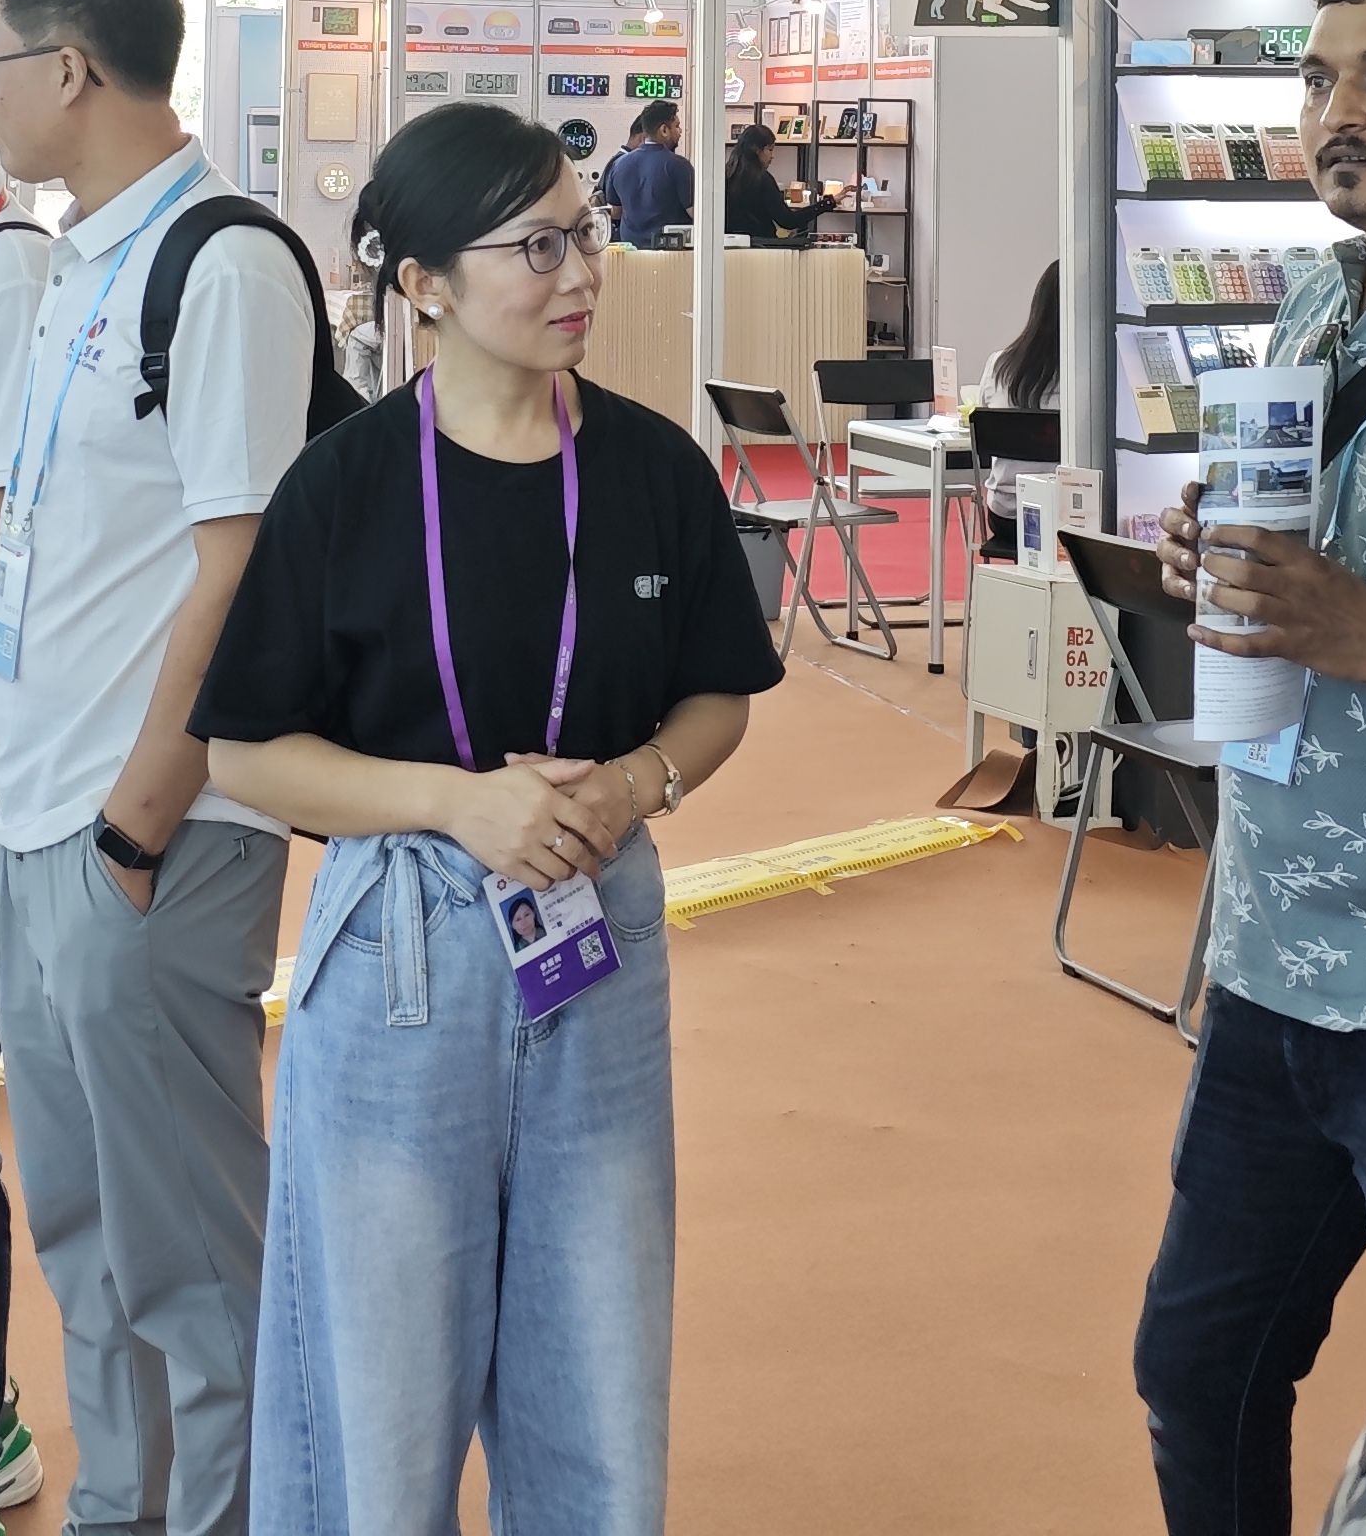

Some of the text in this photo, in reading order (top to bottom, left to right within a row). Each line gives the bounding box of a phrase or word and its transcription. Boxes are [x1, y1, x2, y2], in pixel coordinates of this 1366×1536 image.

[327, 42, 349, 51] Board
[349, 43, 369, 52] Clock
[481, 45, 500, 53] Clock
[1264, 28, 1303, 56] 256
[635, 77, 667, 98] 2:03
[1066, 626, 1095, 647] 配2
[1066, 649, 1090, 668] 6A
